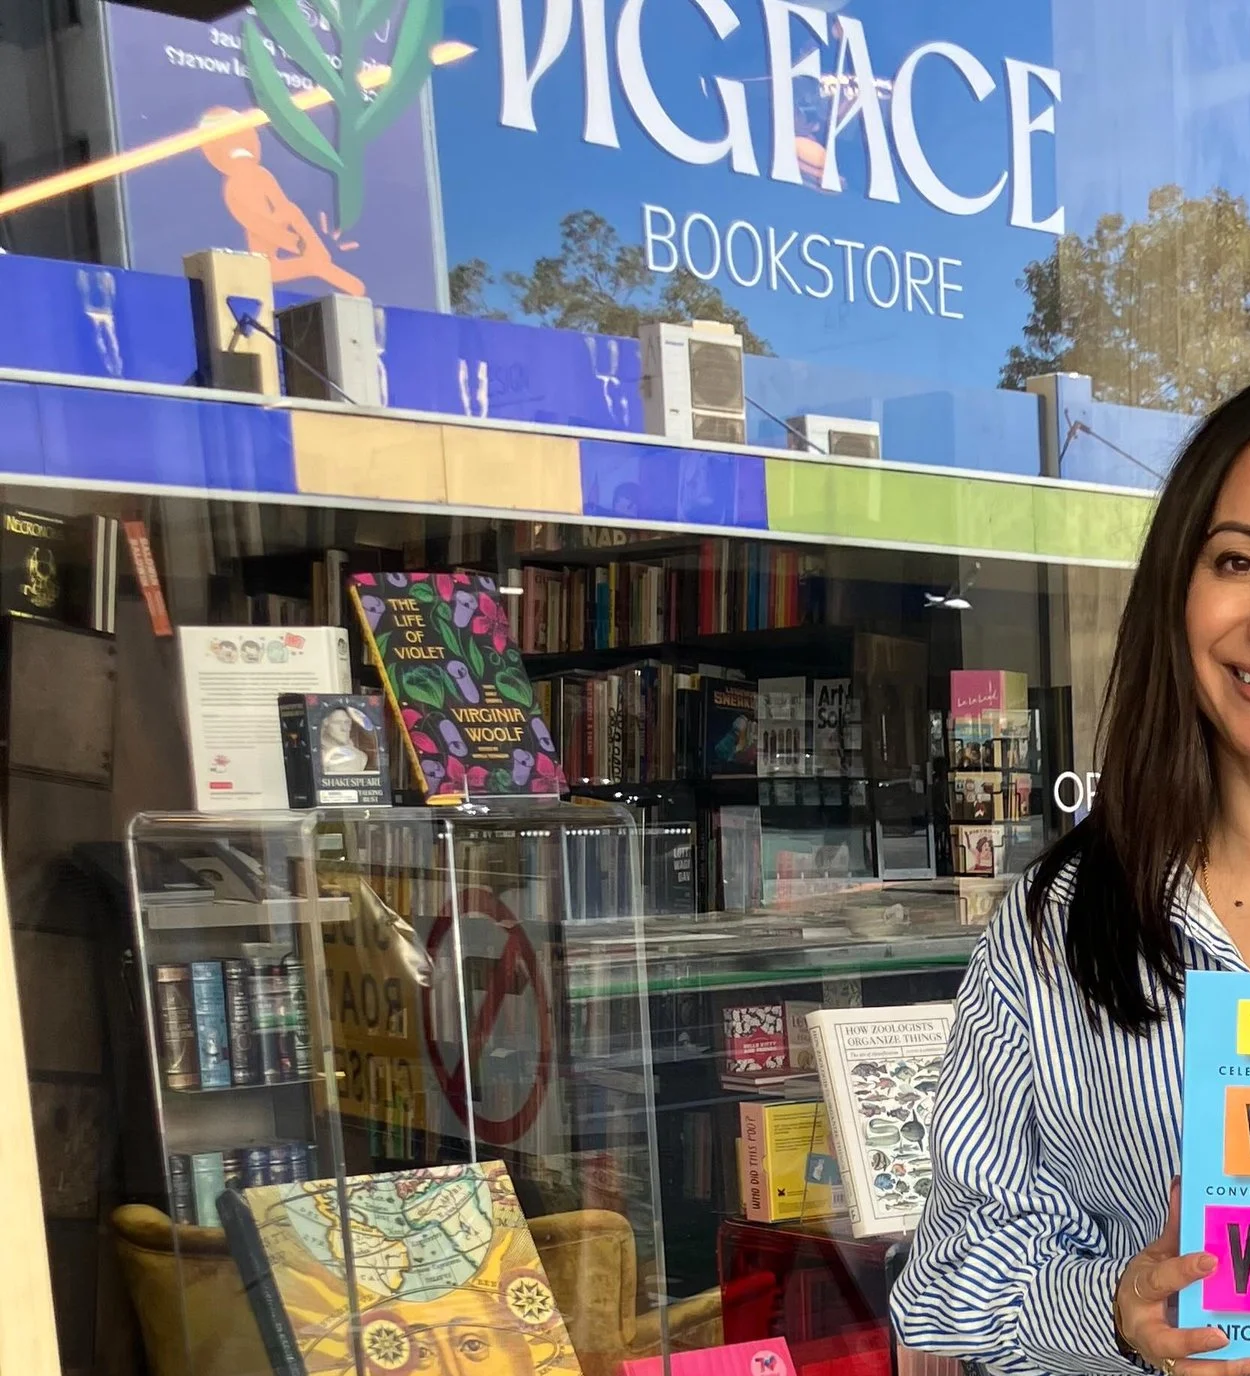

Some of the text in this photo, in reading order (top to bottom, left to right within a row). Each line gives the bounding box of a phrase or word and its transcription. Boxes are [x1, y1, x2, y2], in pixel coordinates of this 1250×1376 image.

[499, 0, 1065, 235] PIGFACE
[642, 203, 966, 320] BOOKSTORE
[388, 599, 420, 612] THE
[395, 615, 427, 628] LIFE
[405, 631, 425, 643] OF
[394, 647, 446, 660] VIOLET
[451, 708, 527, 723] VIRGINIA
[464, 727, 525, 742] WOOLF
[845, 1021, 935, 1036] HOW ZOOLOGISTS
[847, 1032, 943, 1047] ORGANIZE THINGS
[746, 1116, 760, 1209] WHO DID THIS POO?
